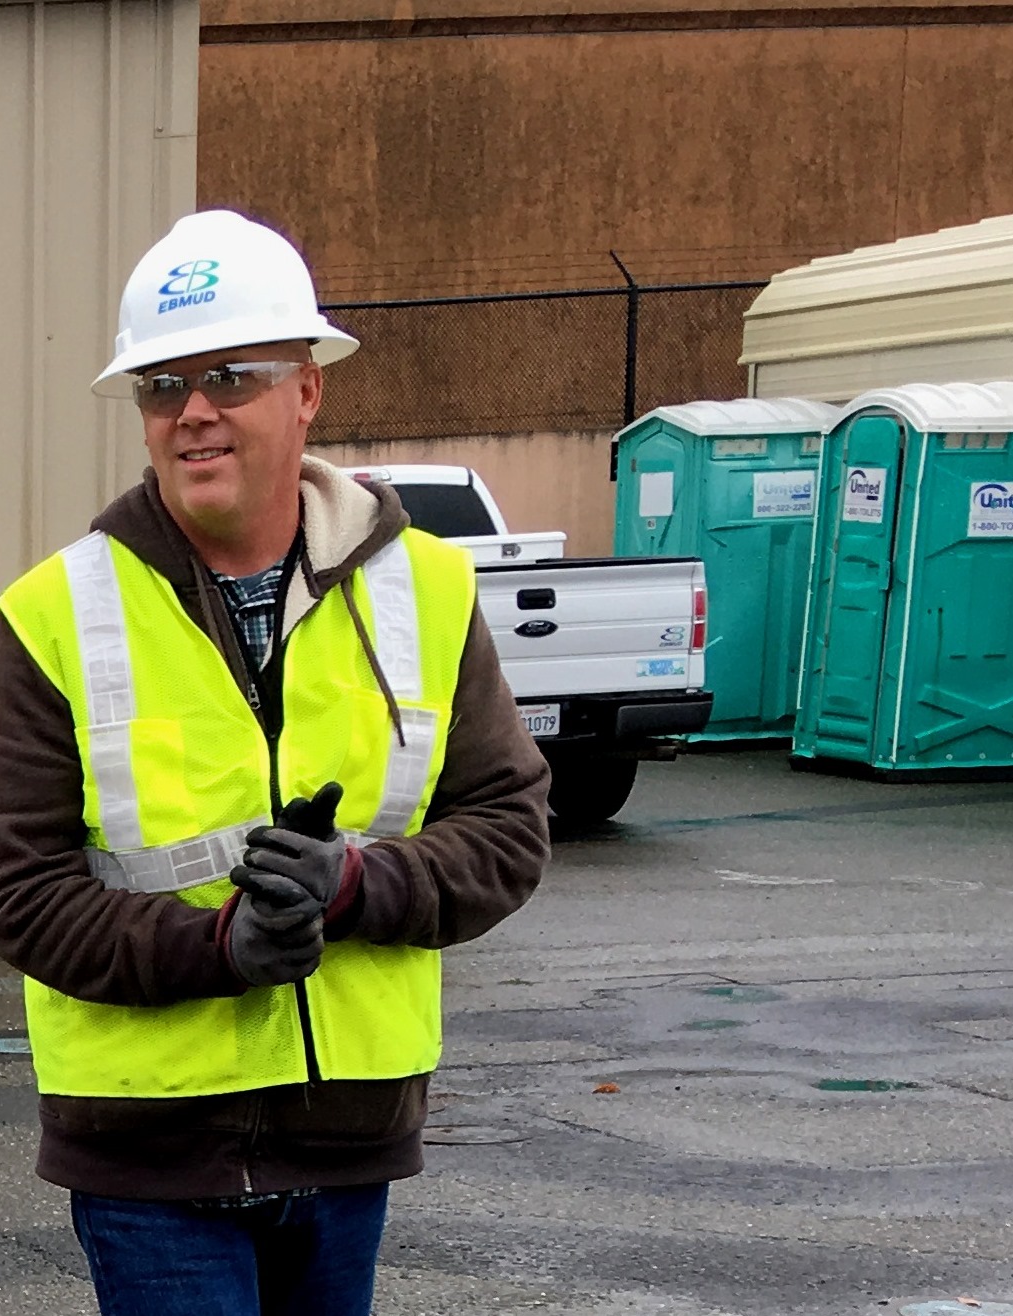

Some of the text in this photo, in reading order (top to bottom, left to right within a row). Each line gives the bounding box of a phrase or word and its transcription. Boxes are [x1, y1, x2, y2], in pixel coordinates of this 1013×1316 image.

[157, 291, 216, 314] EBMUD
[763, 480, 811, 495] United
[851, 479, 881, 494] United
[521, 716, 556, 732] 1079
